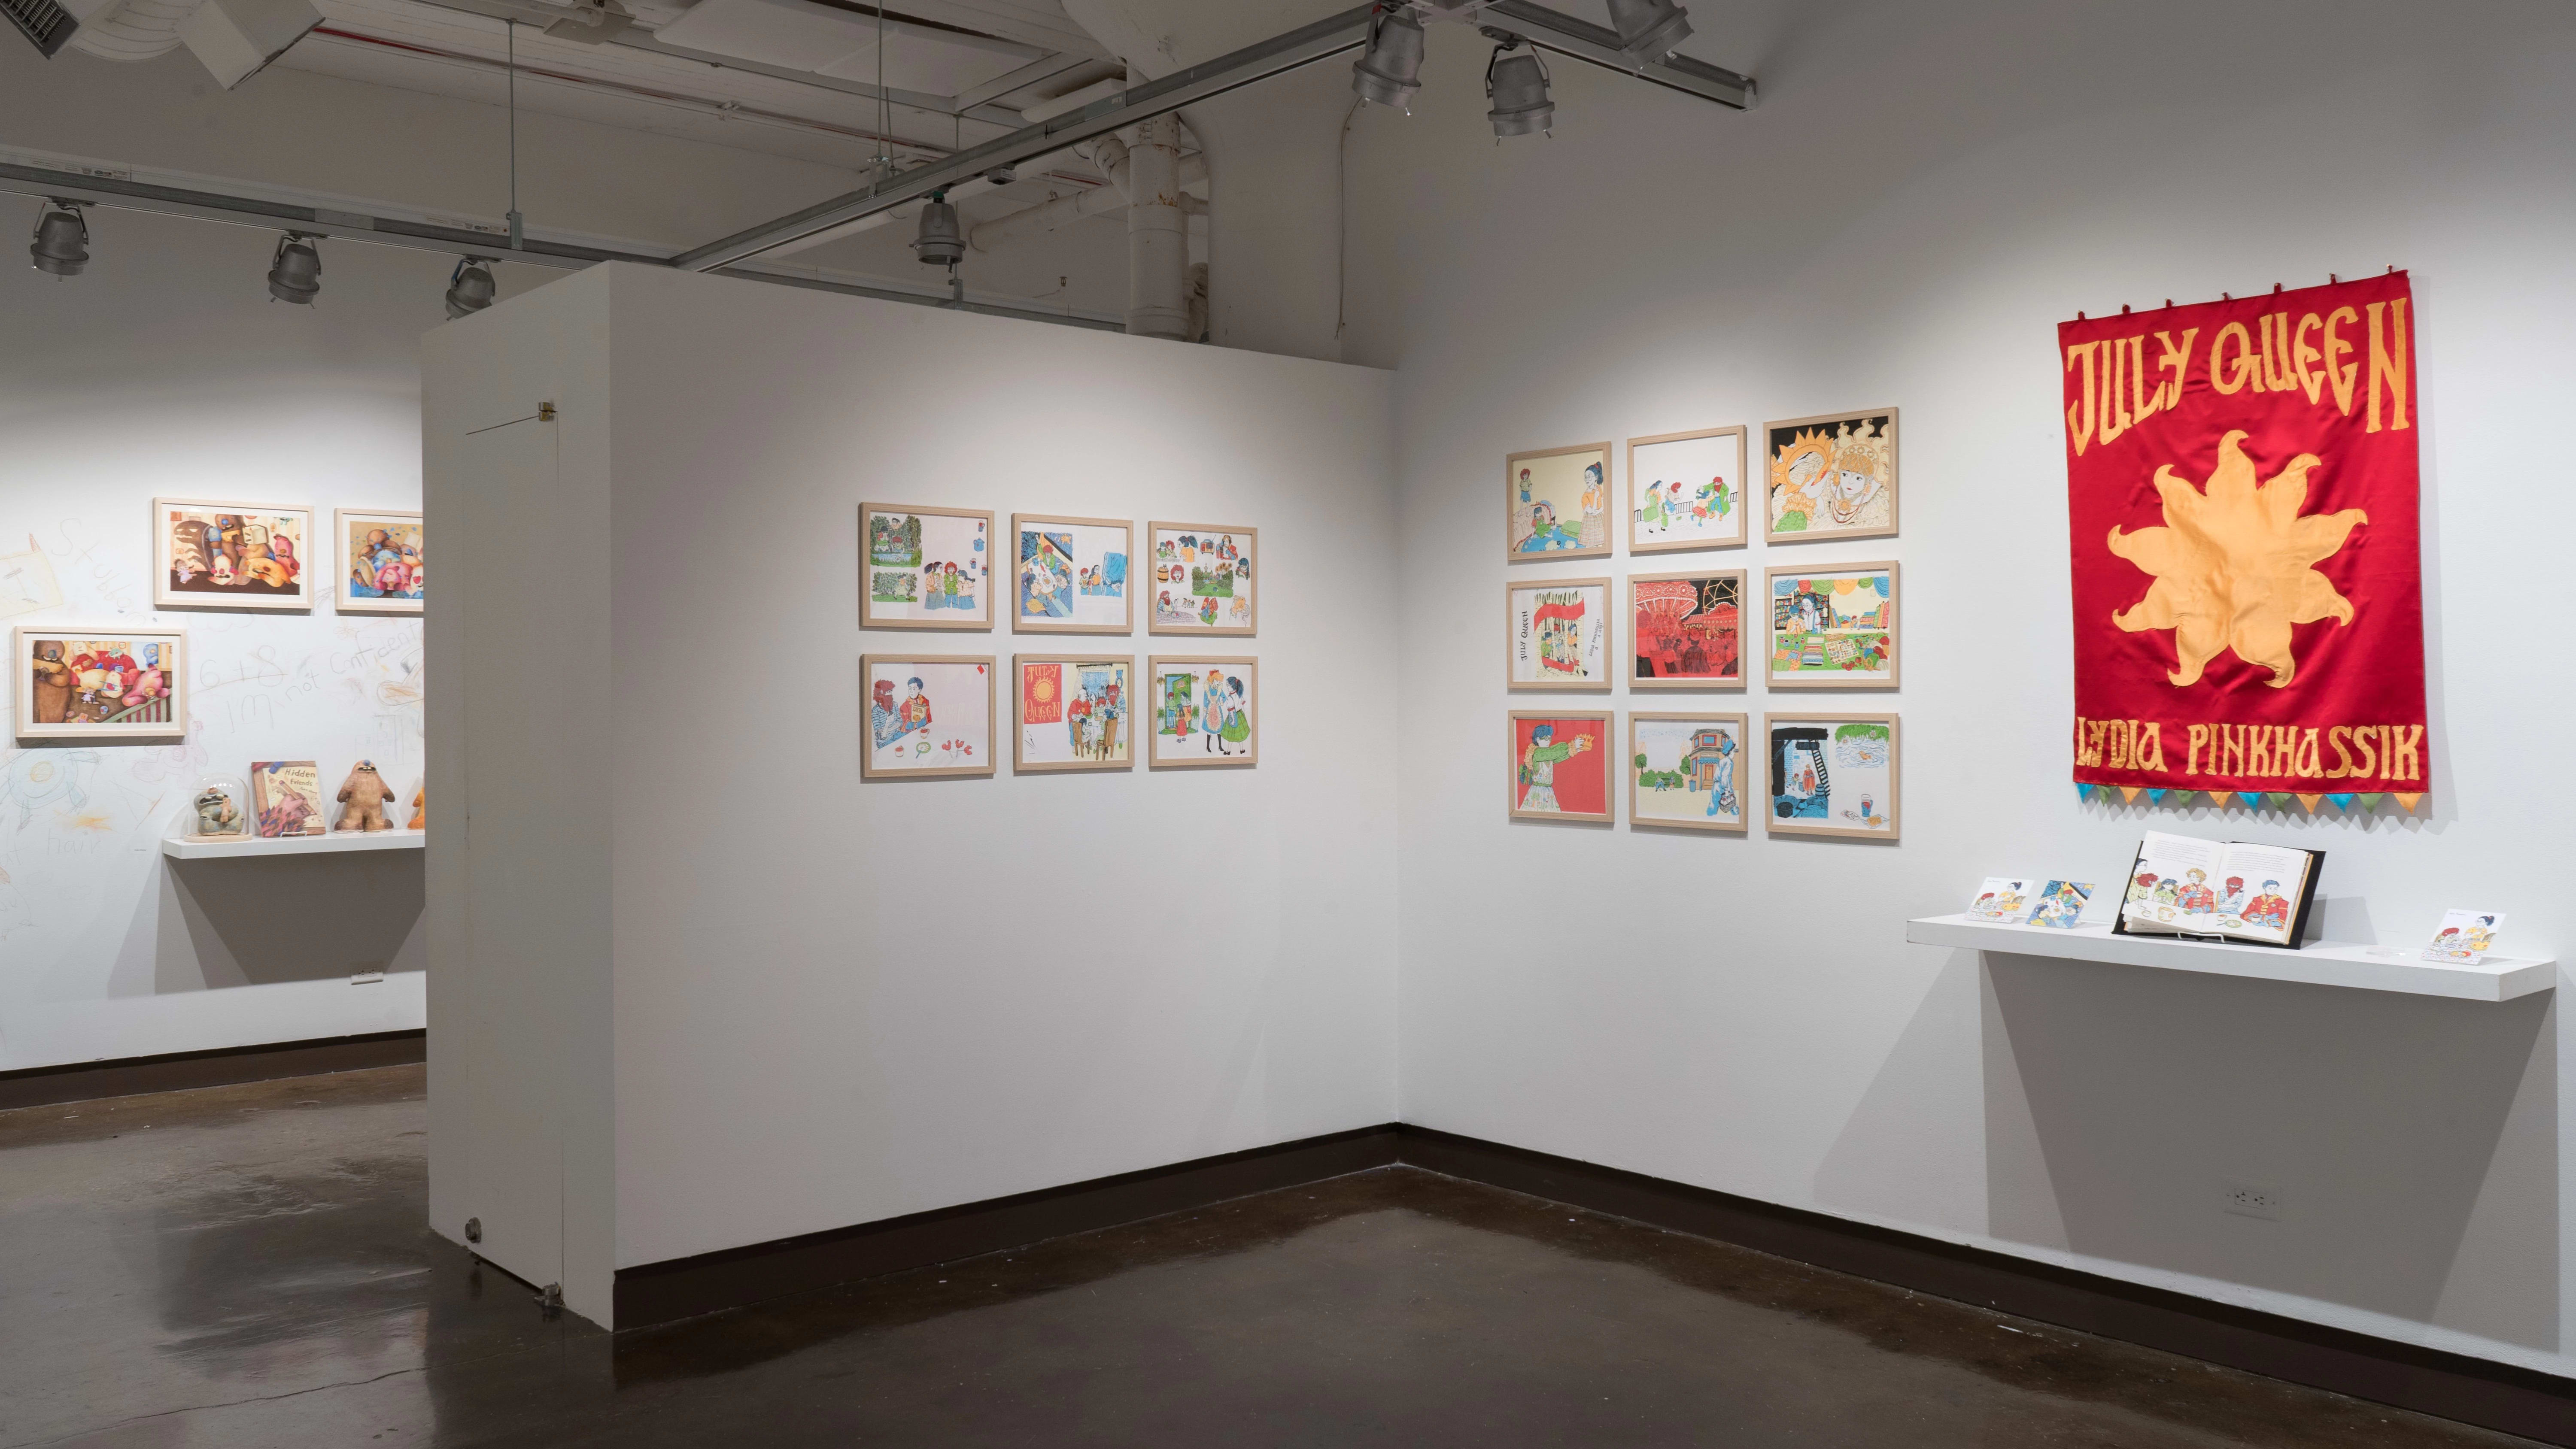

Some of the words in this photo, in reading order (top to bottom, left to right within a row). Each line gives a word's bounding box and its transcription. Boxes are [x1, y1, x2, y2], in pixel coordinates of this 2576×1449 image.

[2067, 327, 2199, 456] JULY
[2210, 297, 2410, 434] QUEEN
[1521, 611, 1529, 638] QUEEN
[1027, 666, 1059, 683] JULY
[1025, 699, 1060, 722] QUEEN
[2076, 717, 2168, 773] LYDIA
[2185, 723, 2424, 781] PINKHASSIK
[285, 768, 316, 778] Hidden
[290, 778, 313, 786] Friends
